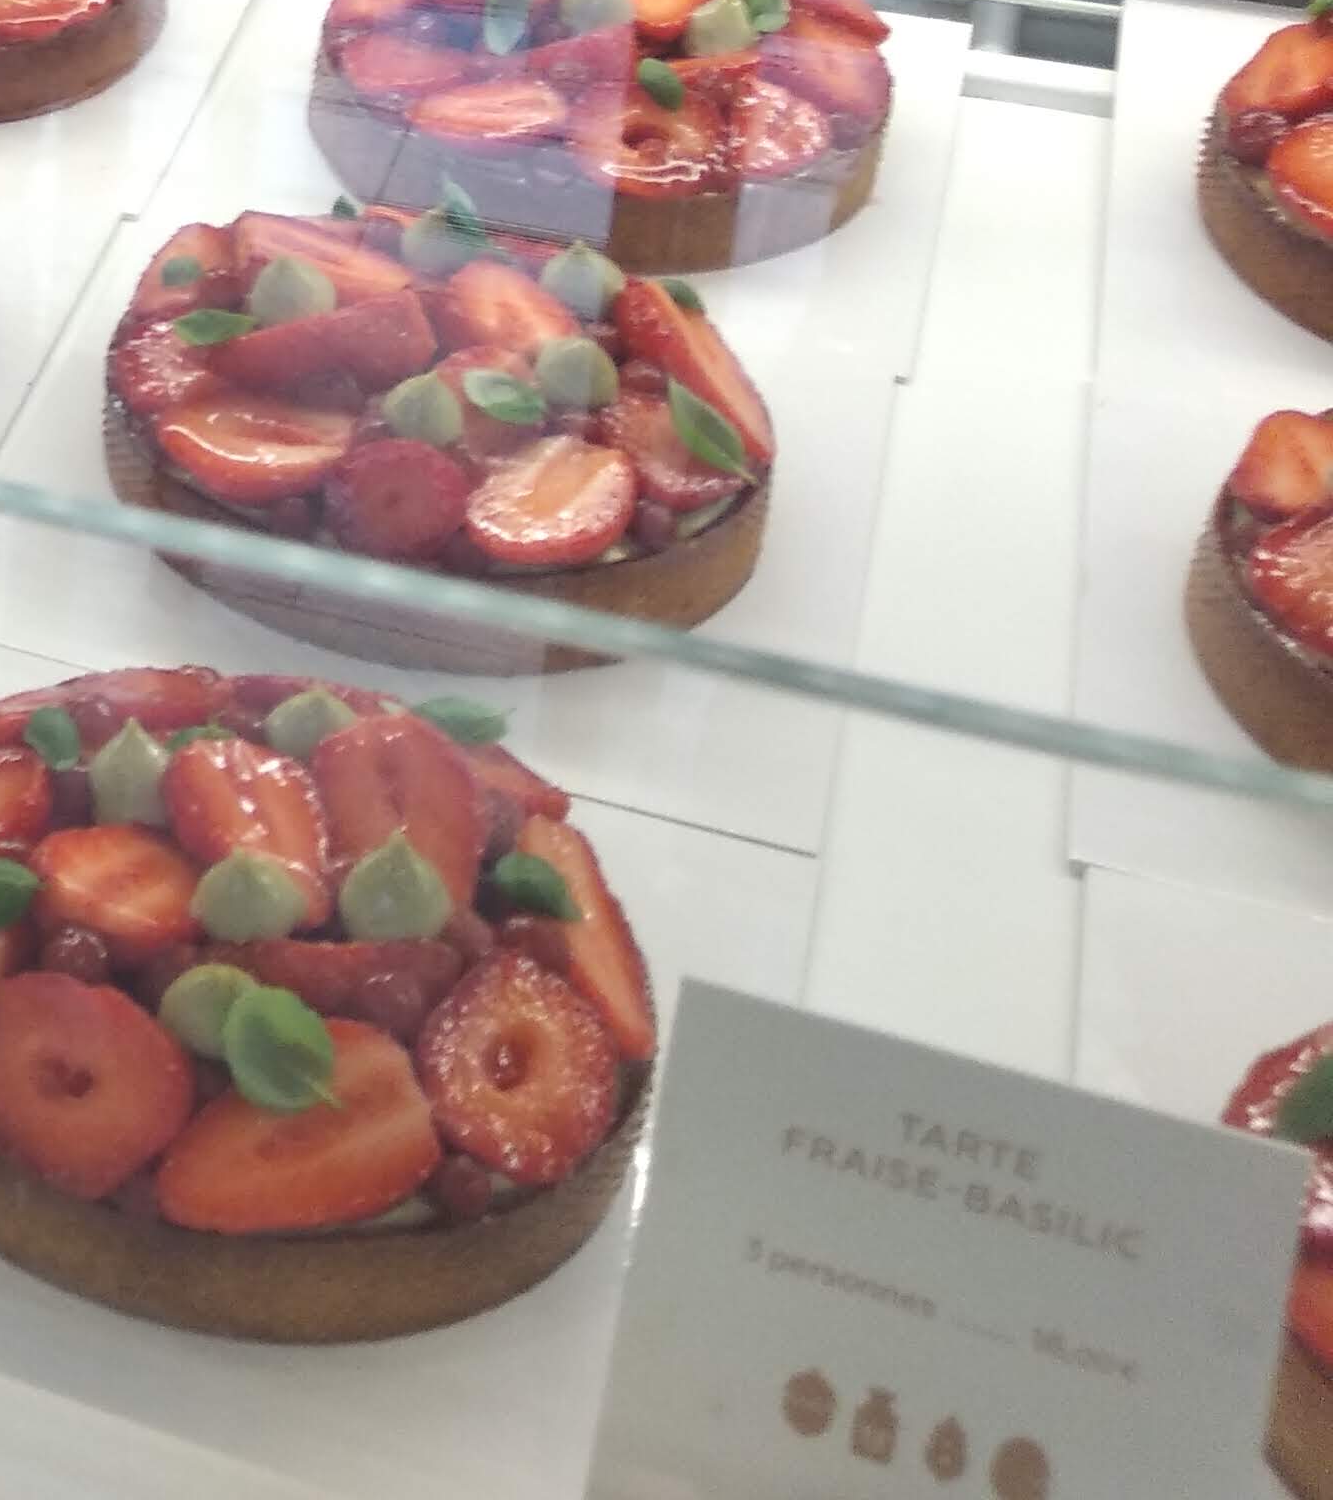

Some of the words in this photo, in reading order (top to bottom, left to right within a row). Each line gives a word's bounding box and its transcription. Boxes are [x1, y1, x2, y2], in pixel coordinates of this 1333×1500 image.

[899, 1111, 1044, 1181] TARTE
[781, 1125, 1145, 1261] FRAISE-BASILIC
[767, 1249, 938, 1321] personnes
